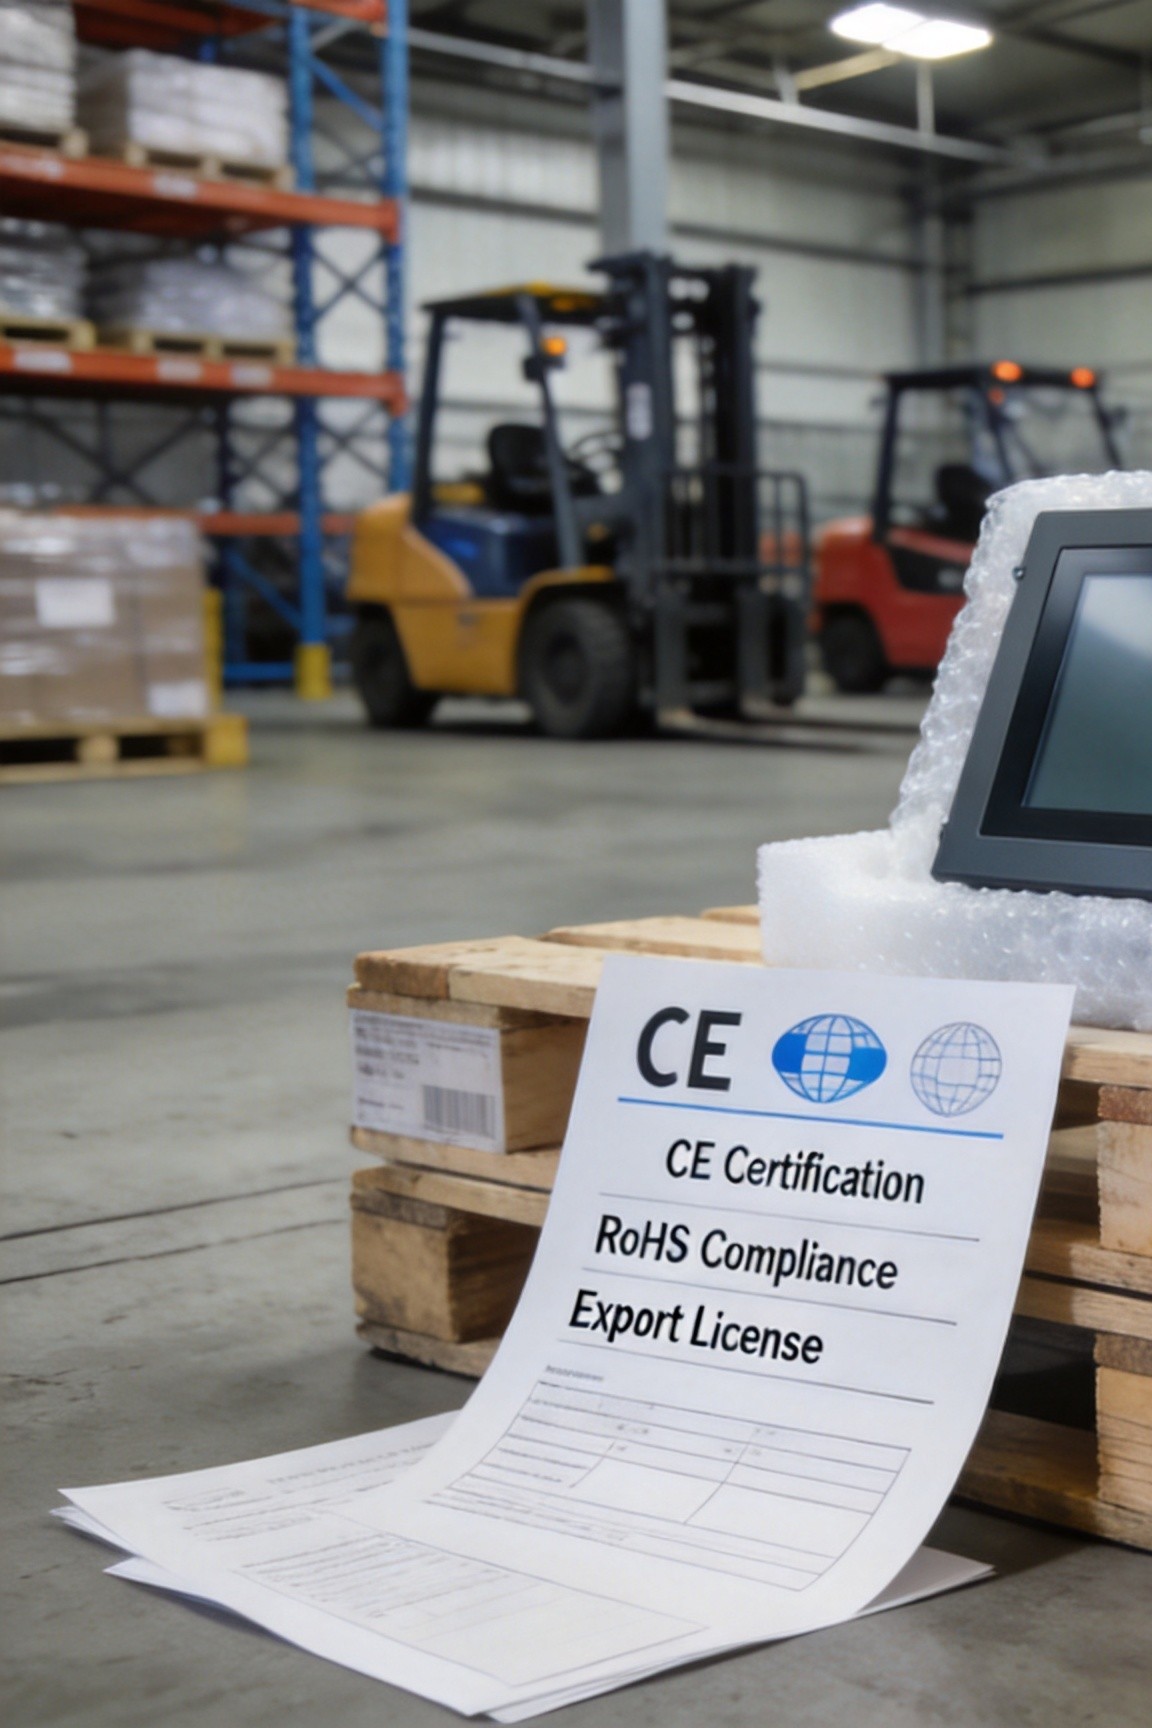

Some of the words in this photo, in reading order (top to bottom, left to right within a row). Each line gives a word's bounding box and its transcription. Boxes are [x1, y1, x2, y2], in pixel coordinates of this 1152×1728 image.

[636, 1006, 742, 1092] CE
[665, 1138, 716, 1180] CE
[724, 1145, 925, 1204] Certification
[595, 1214, 690, 1264] RoHS
[700, 1229, 899, 1290] Compliance
[568, 1288, 684, 1344] Export
[689, 1304, 824, 1365] License
